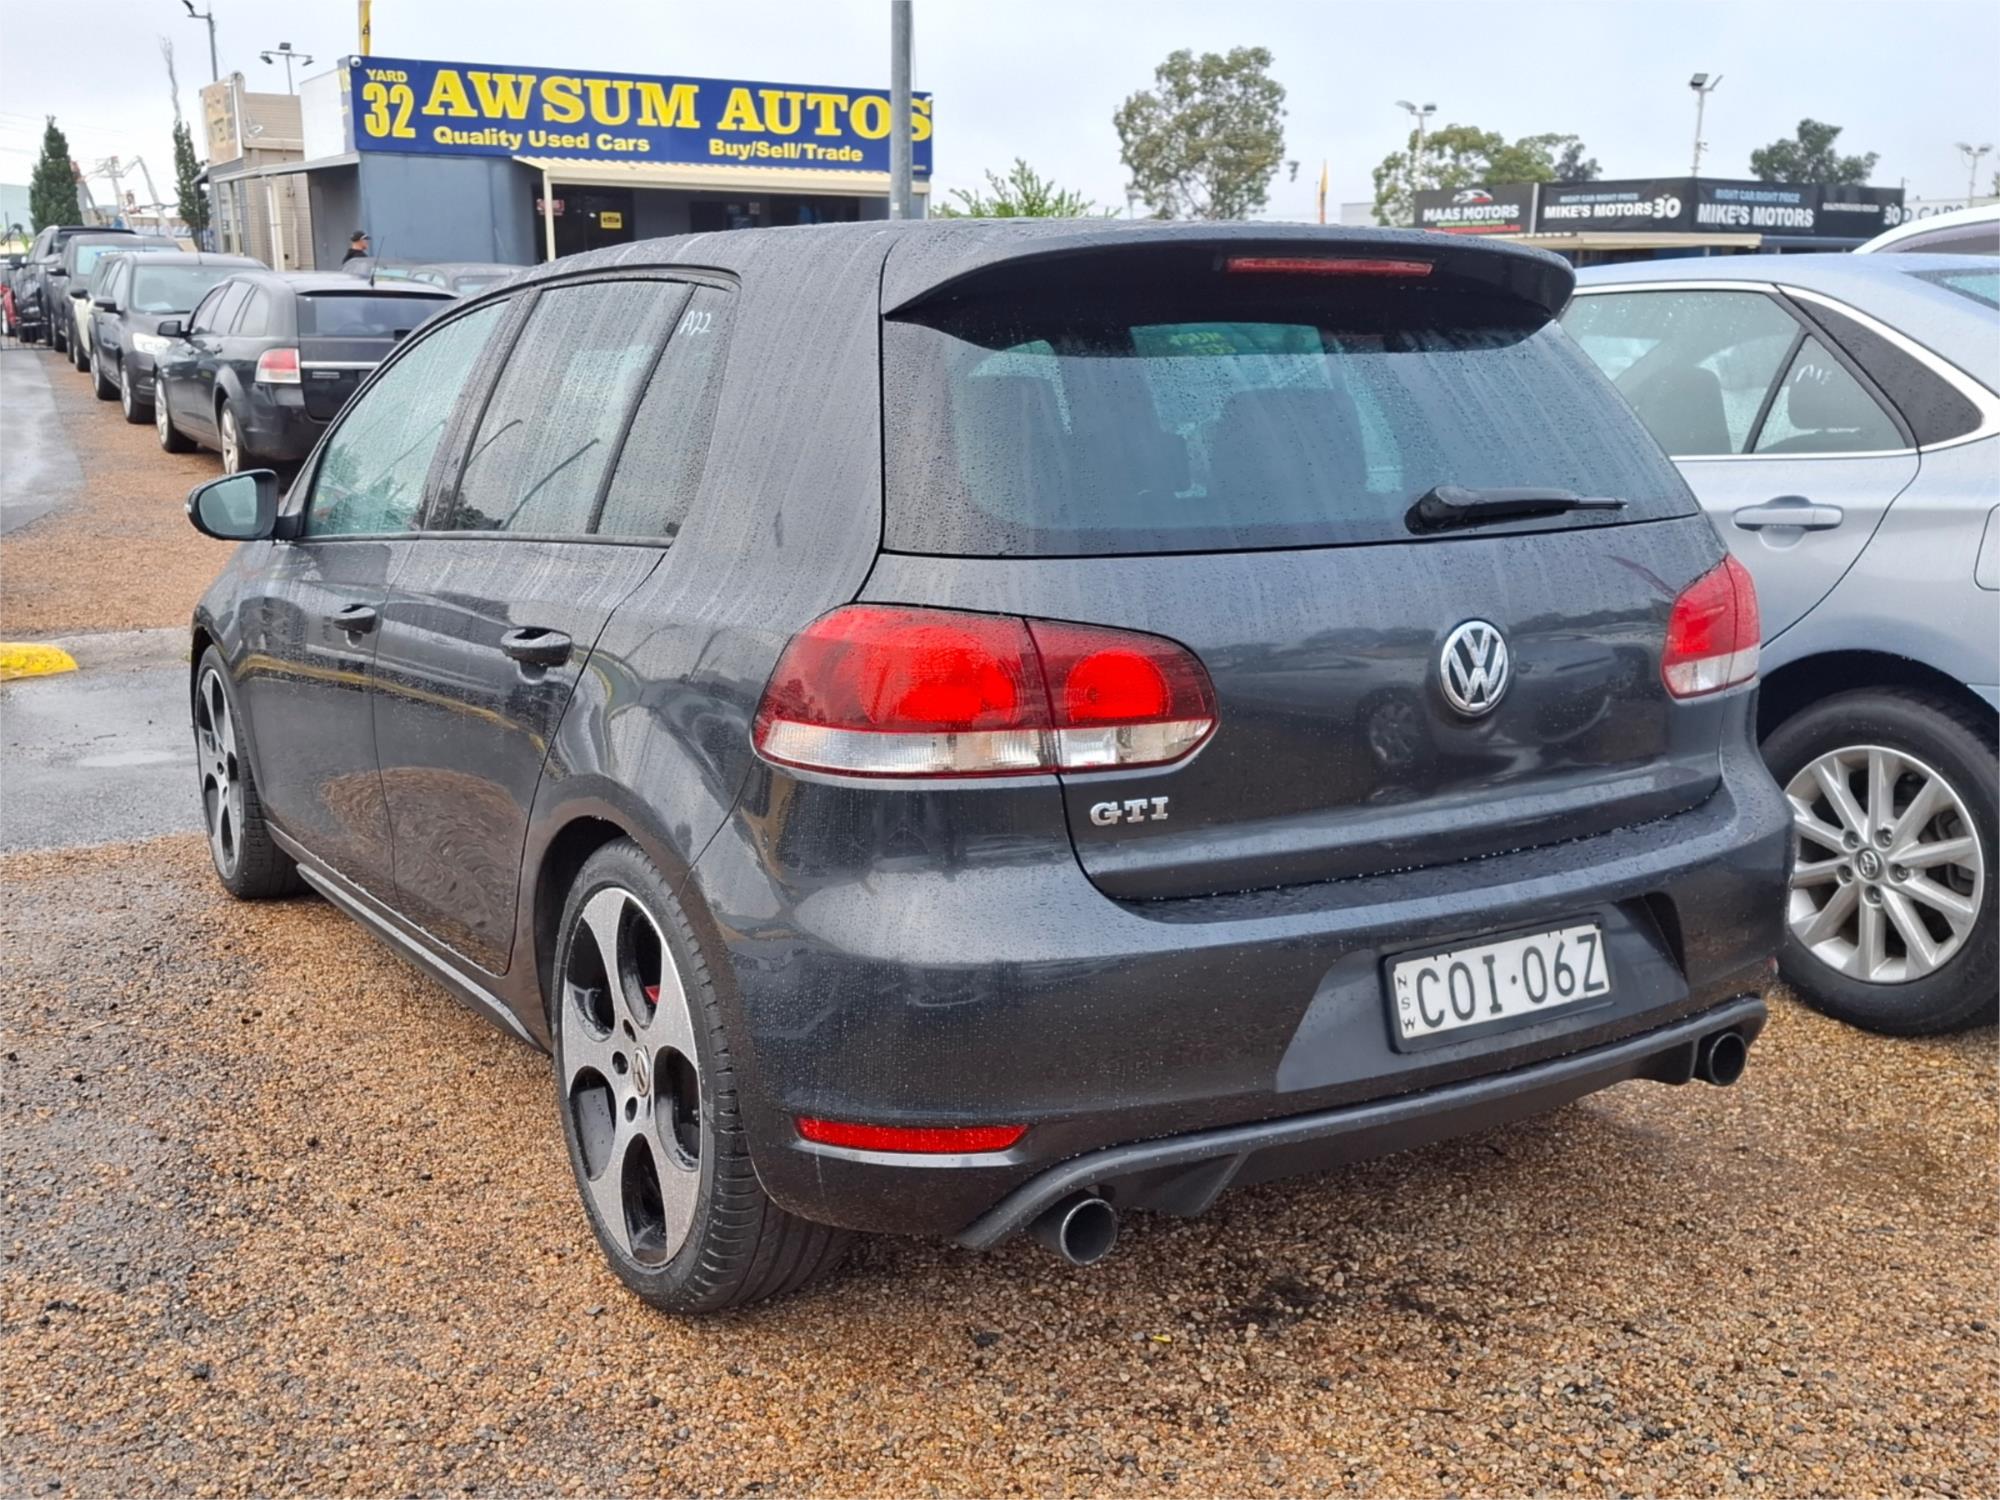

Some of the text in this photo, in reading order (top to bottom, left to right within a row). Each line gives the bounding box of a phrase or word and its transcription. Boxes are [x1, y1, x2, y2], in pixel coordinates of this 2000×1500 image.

[365, 68, 408, 83] YARD
[362, 82, 416, 139] 32
[421, 69, 933, 142] AWSUM AUTOS
[433, 126, 651, 152] Quality Used Cars
[708, 138, 864, 163] Buy/Sell/Trade
[1422, 204, 1519, 222] MAAS MOTORS
[1544, 196, 1681, 219] MIKE'S MOTORS 30
[1697, 203, 1750, 225] MIKE'S
[1752, 206, 1814, 228] MOTORS
[1090, 796, 1169, 826] GTI
